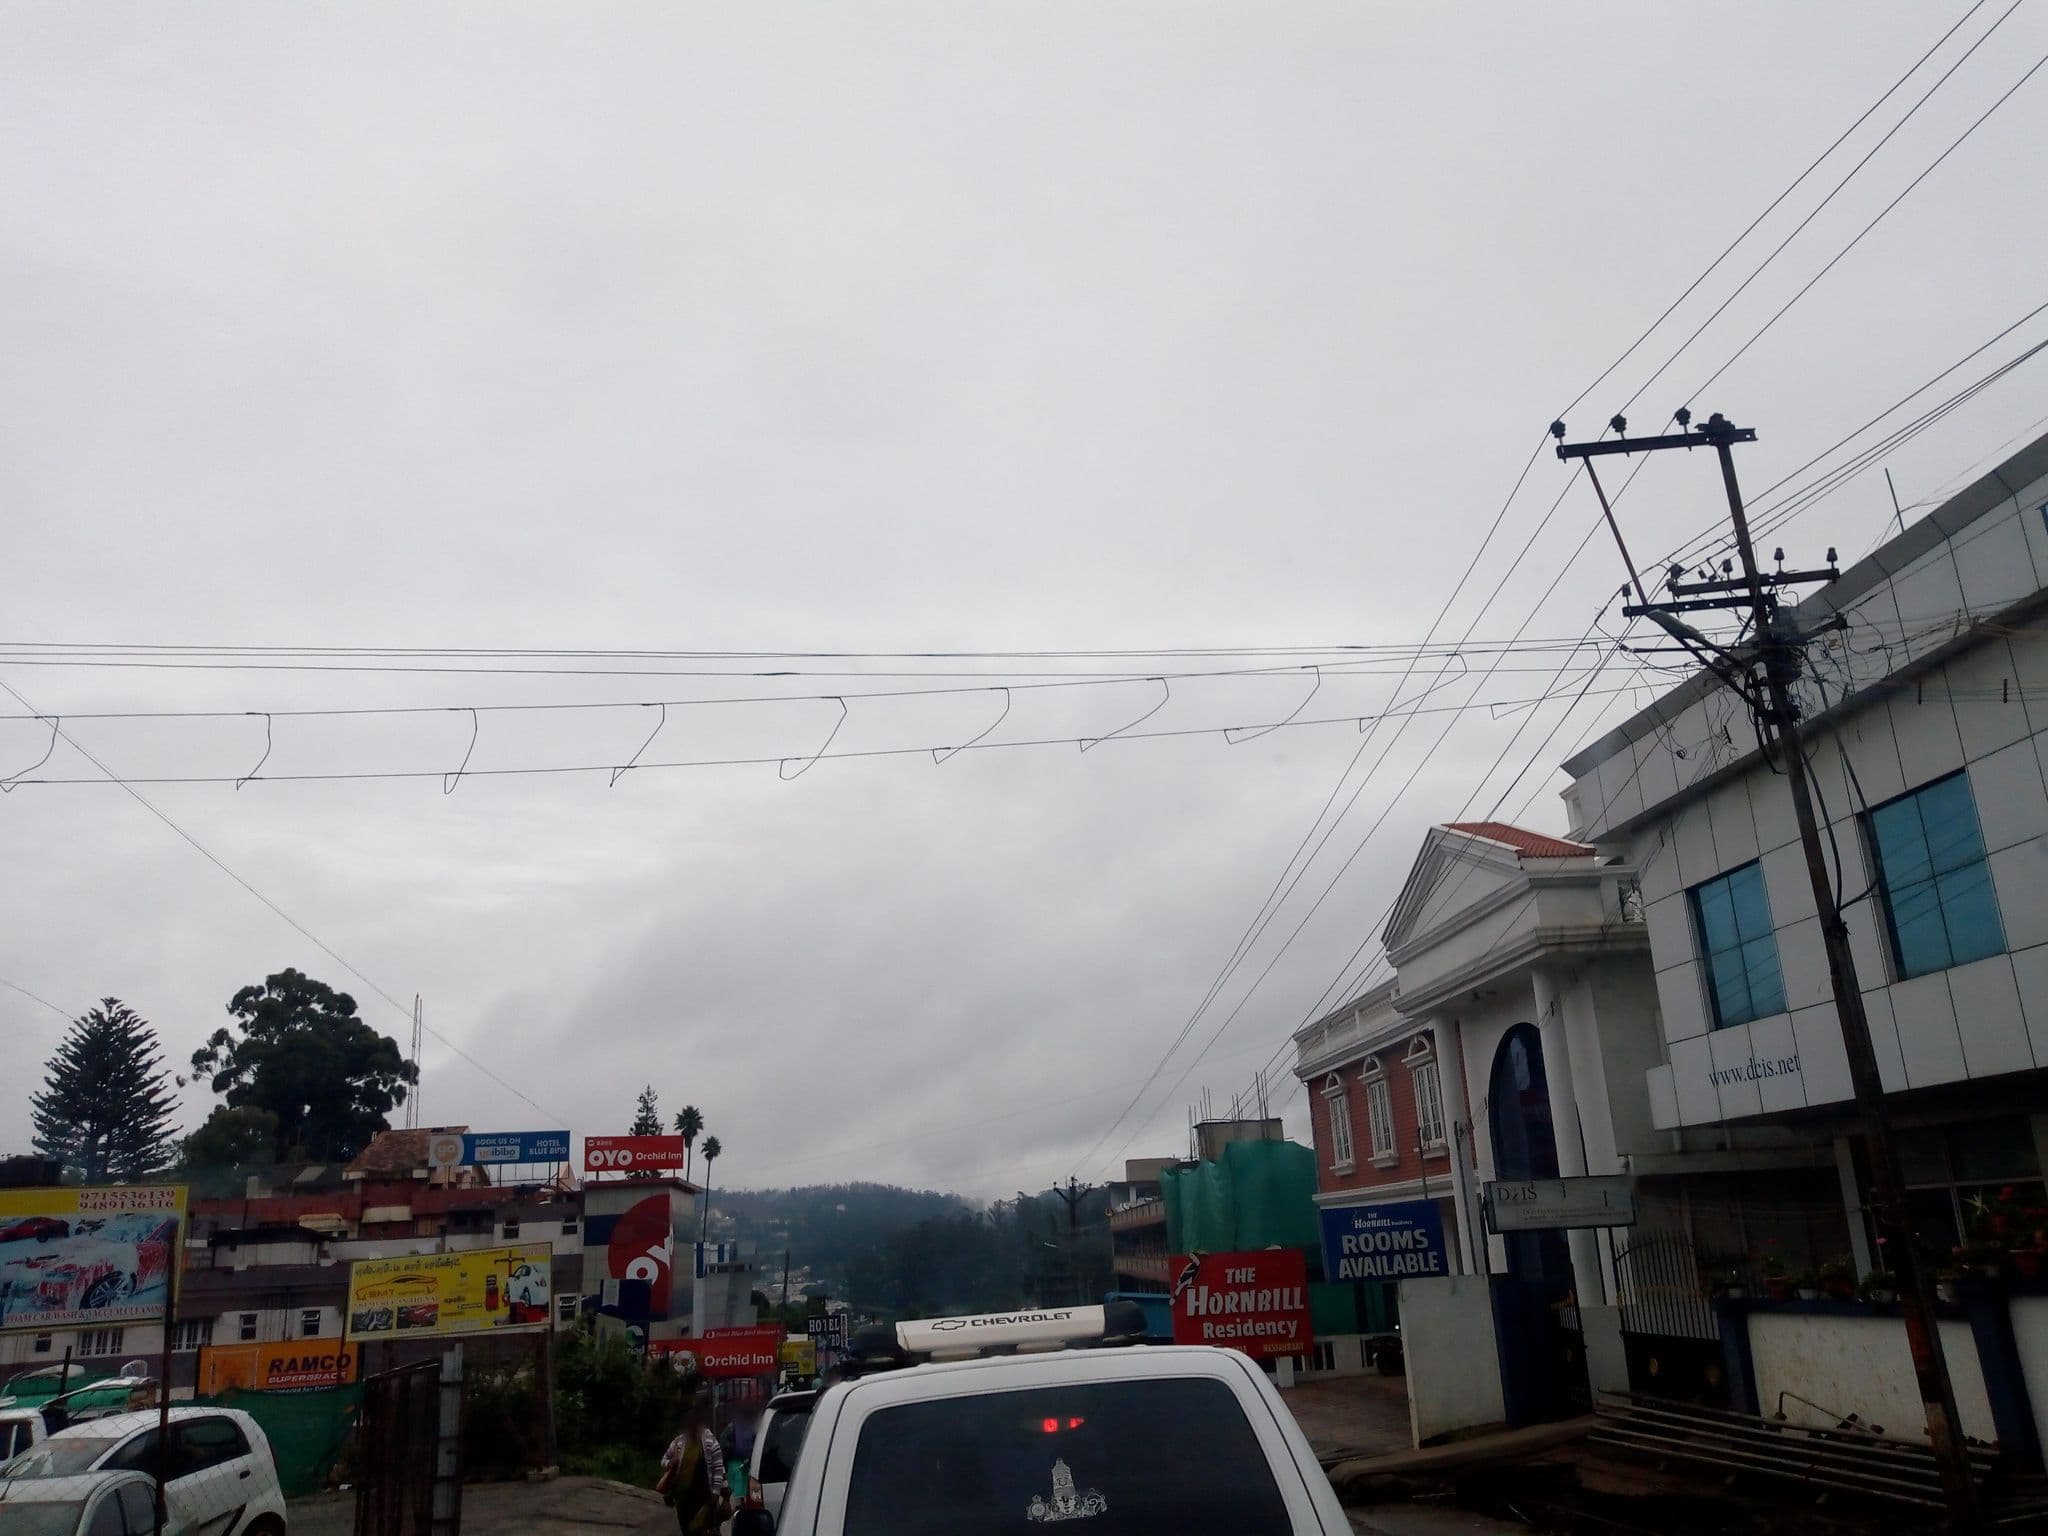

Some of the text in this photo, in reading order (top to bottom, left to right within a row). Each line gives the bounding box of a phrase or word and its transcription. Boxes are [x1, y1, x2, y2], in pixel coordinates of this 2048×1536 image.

[1708, 1054, 1801, 1088] www.dcis.net
[475, 1136, 521, 1146] BOOK US ON
[536, 1139, 561, 1147] HOTEL
[528, 1148, 549, 1156] BLUE
[588, 1149, 683, 1167] OYO Orchid Inn
[1341, 1228, 1429, 1255] ROOMS
[1338, 1251, 1440, 1279] AVAILABLE
[1224, 1267, 1256, 1284] THE
[1186, 1285, 1305, 1316] HORNBILL
[34, 1312, 52, 1321] CAR
[53, 1311, 77, 1320] WASH
[971, 1312, 1073, 1327] CHEVROLET
[809, 1318, 840, 1333] HOTEL
[1203, 1318, 1298, 1339] Residency
[269, 1353, 352, 1373] RAMCO
[704, 1352, 774, 1367] Orchid Inn
